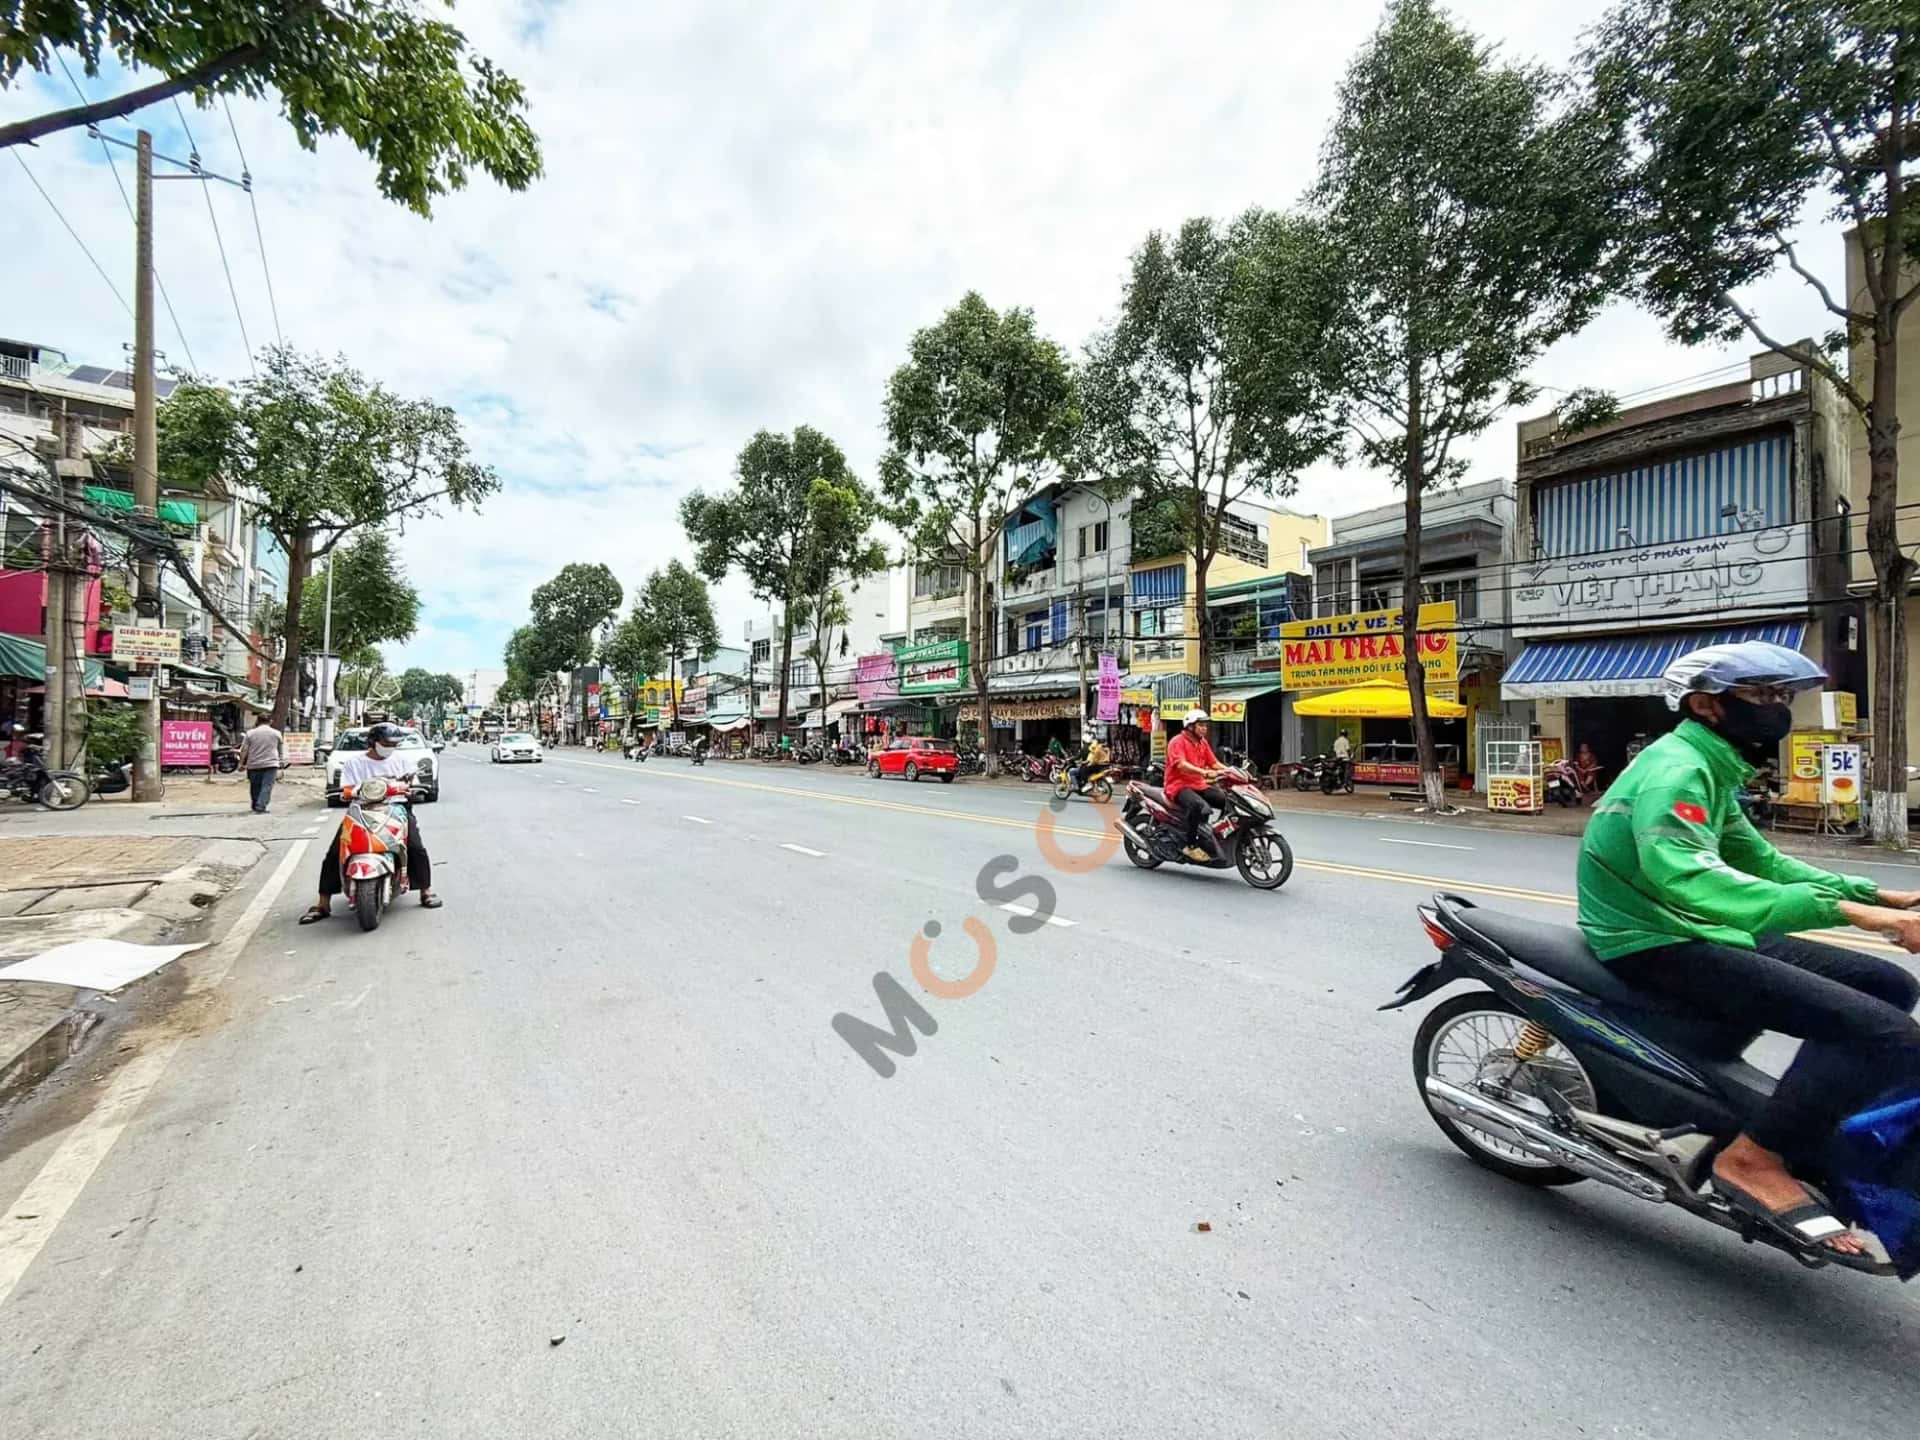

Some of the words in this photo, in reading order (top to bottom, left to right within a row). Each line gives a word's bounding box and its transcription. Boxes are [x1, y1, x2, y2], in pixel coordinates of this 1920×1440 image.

[1610, 556, 1628, 567] TY
[1551, 574, 1617, 609] VIỆT
[1628, 556, 1763, 599] THẮNG
[1284, 639, 1336, 666] MAI
[1832, 750, 1854, 771] 5k
